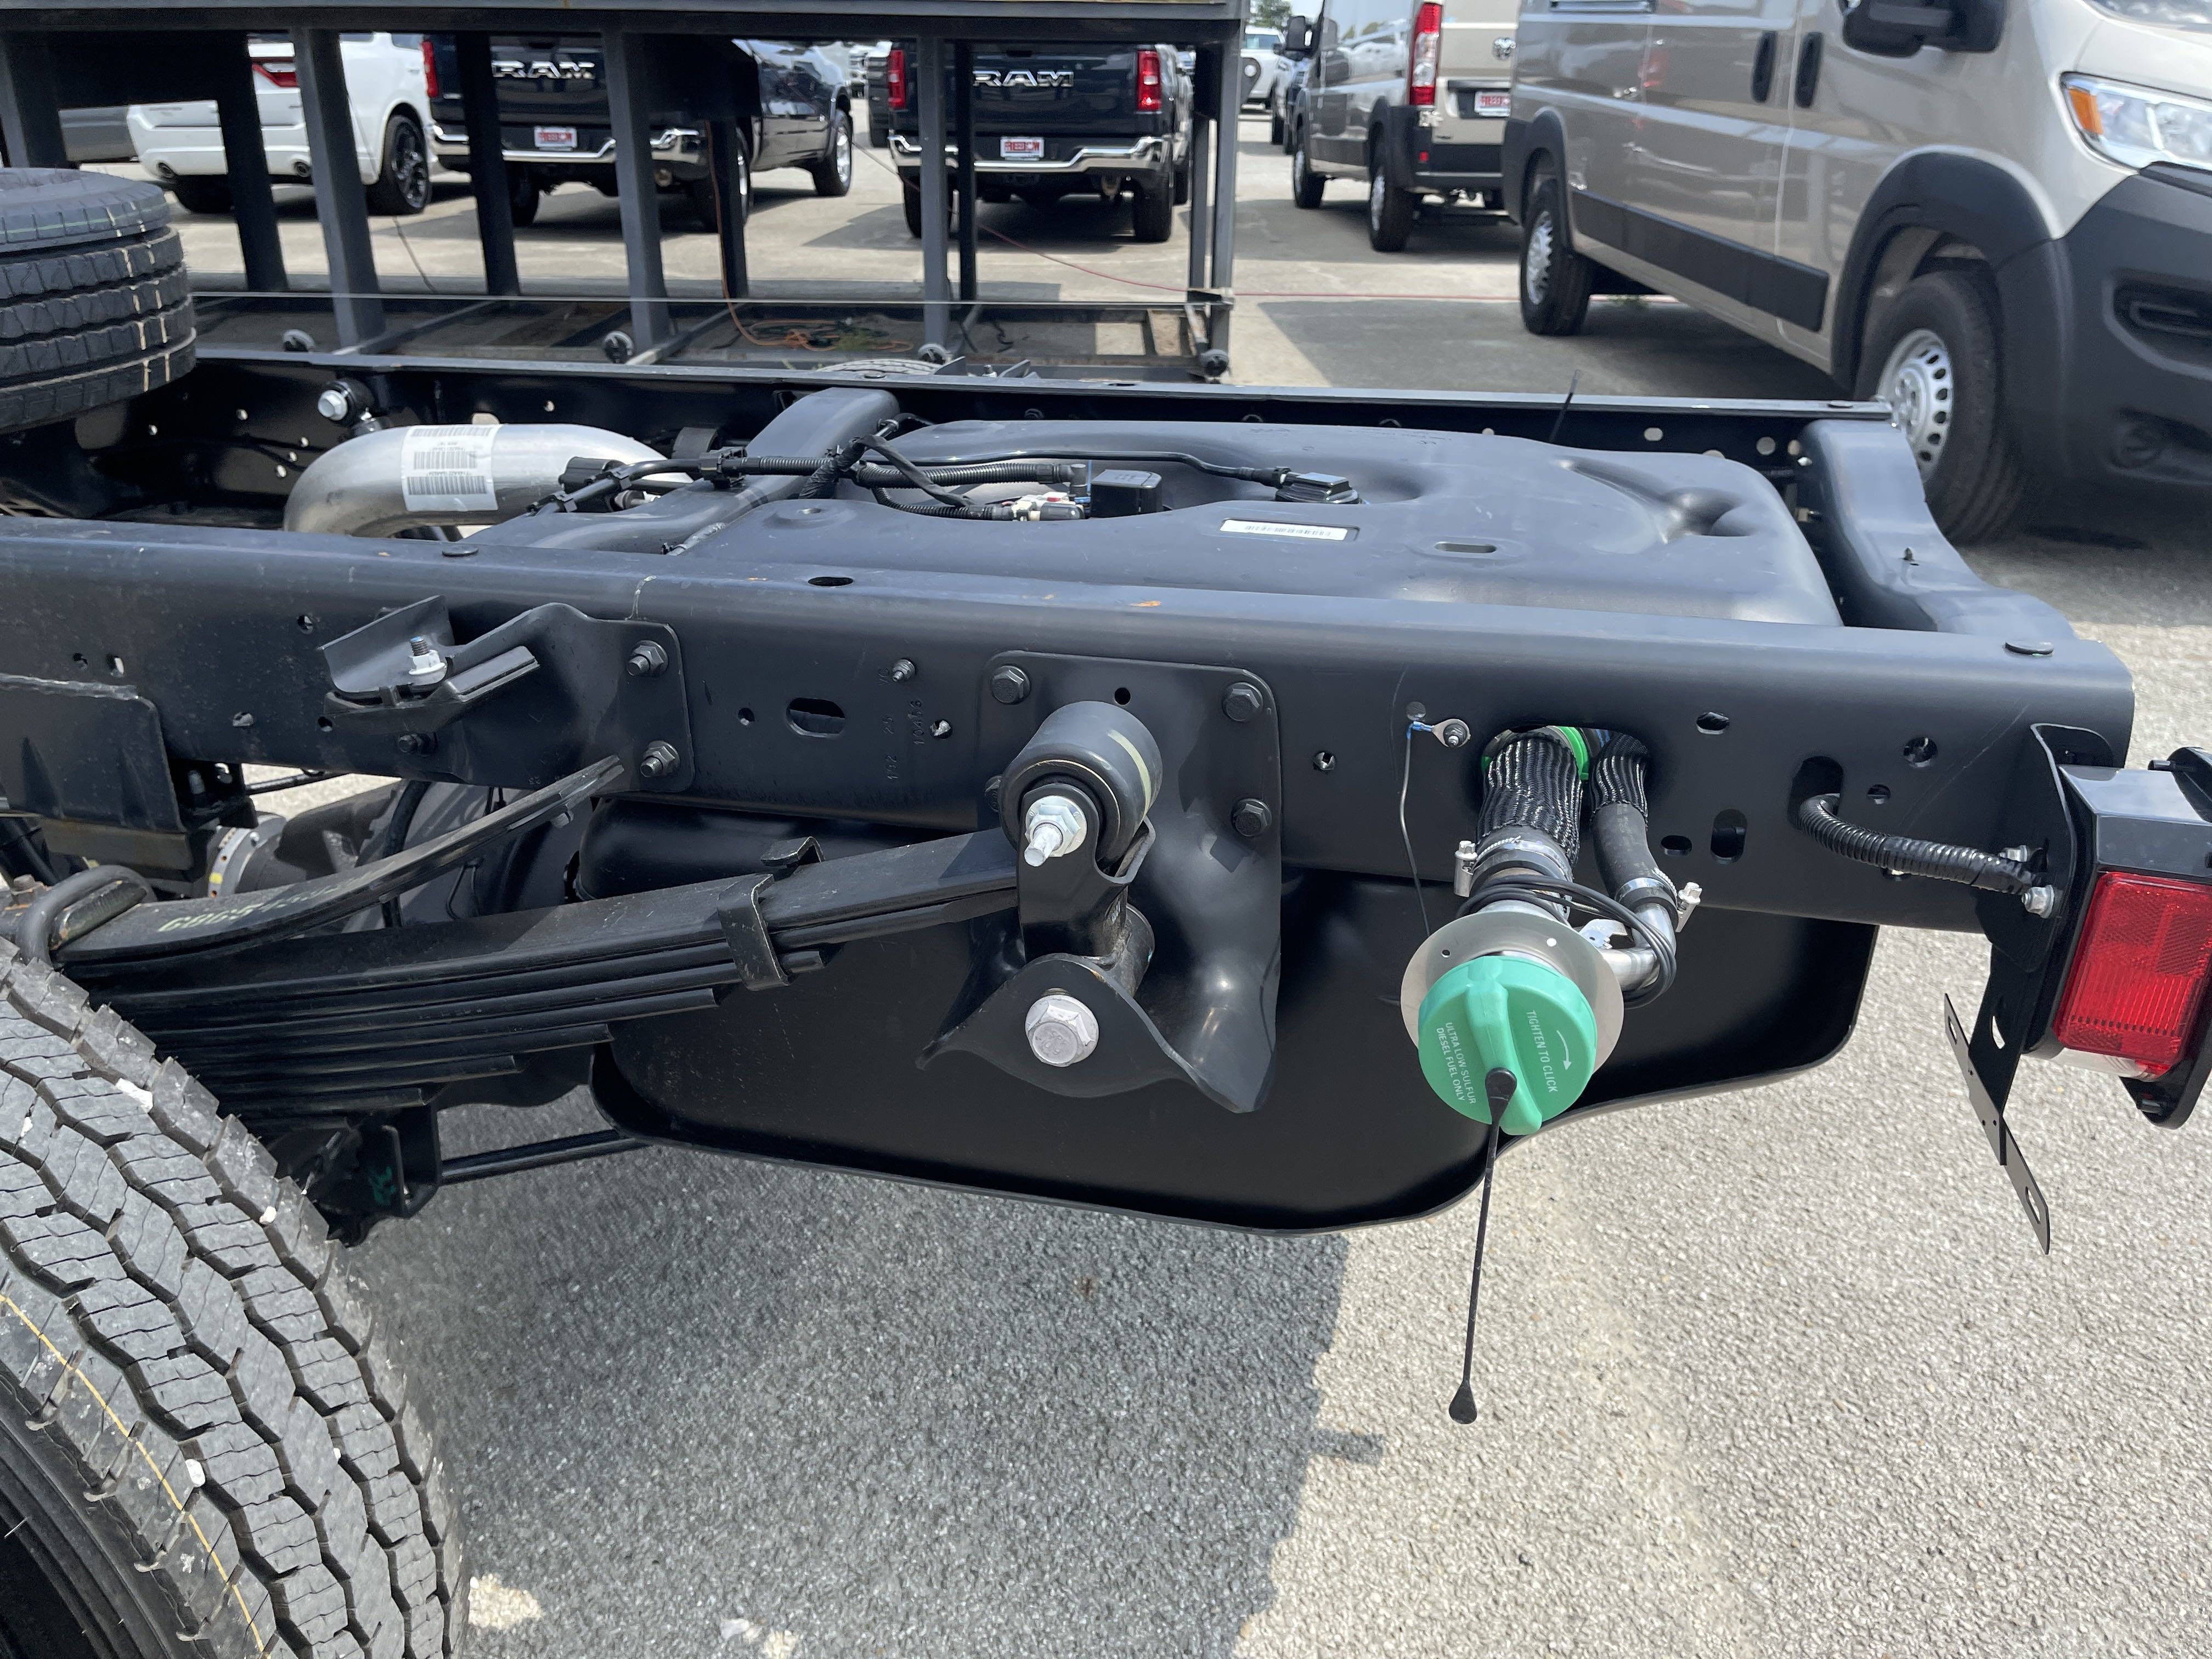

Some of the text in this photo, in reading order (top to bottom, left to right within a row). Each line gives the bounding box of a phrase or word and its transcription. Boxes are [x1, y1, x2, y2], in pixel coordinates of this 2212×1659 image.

[492, 60, 595, 79] RAM
[973, 70, 1074, 87] RAM
[1446, 1022, 1460, 1047] ULTRA
[1527, 1010, 1558, 1092] TIGHTEN TO CLICK
[1436, 1028, 1465, 1101] DIESEL FUEL ONLY
